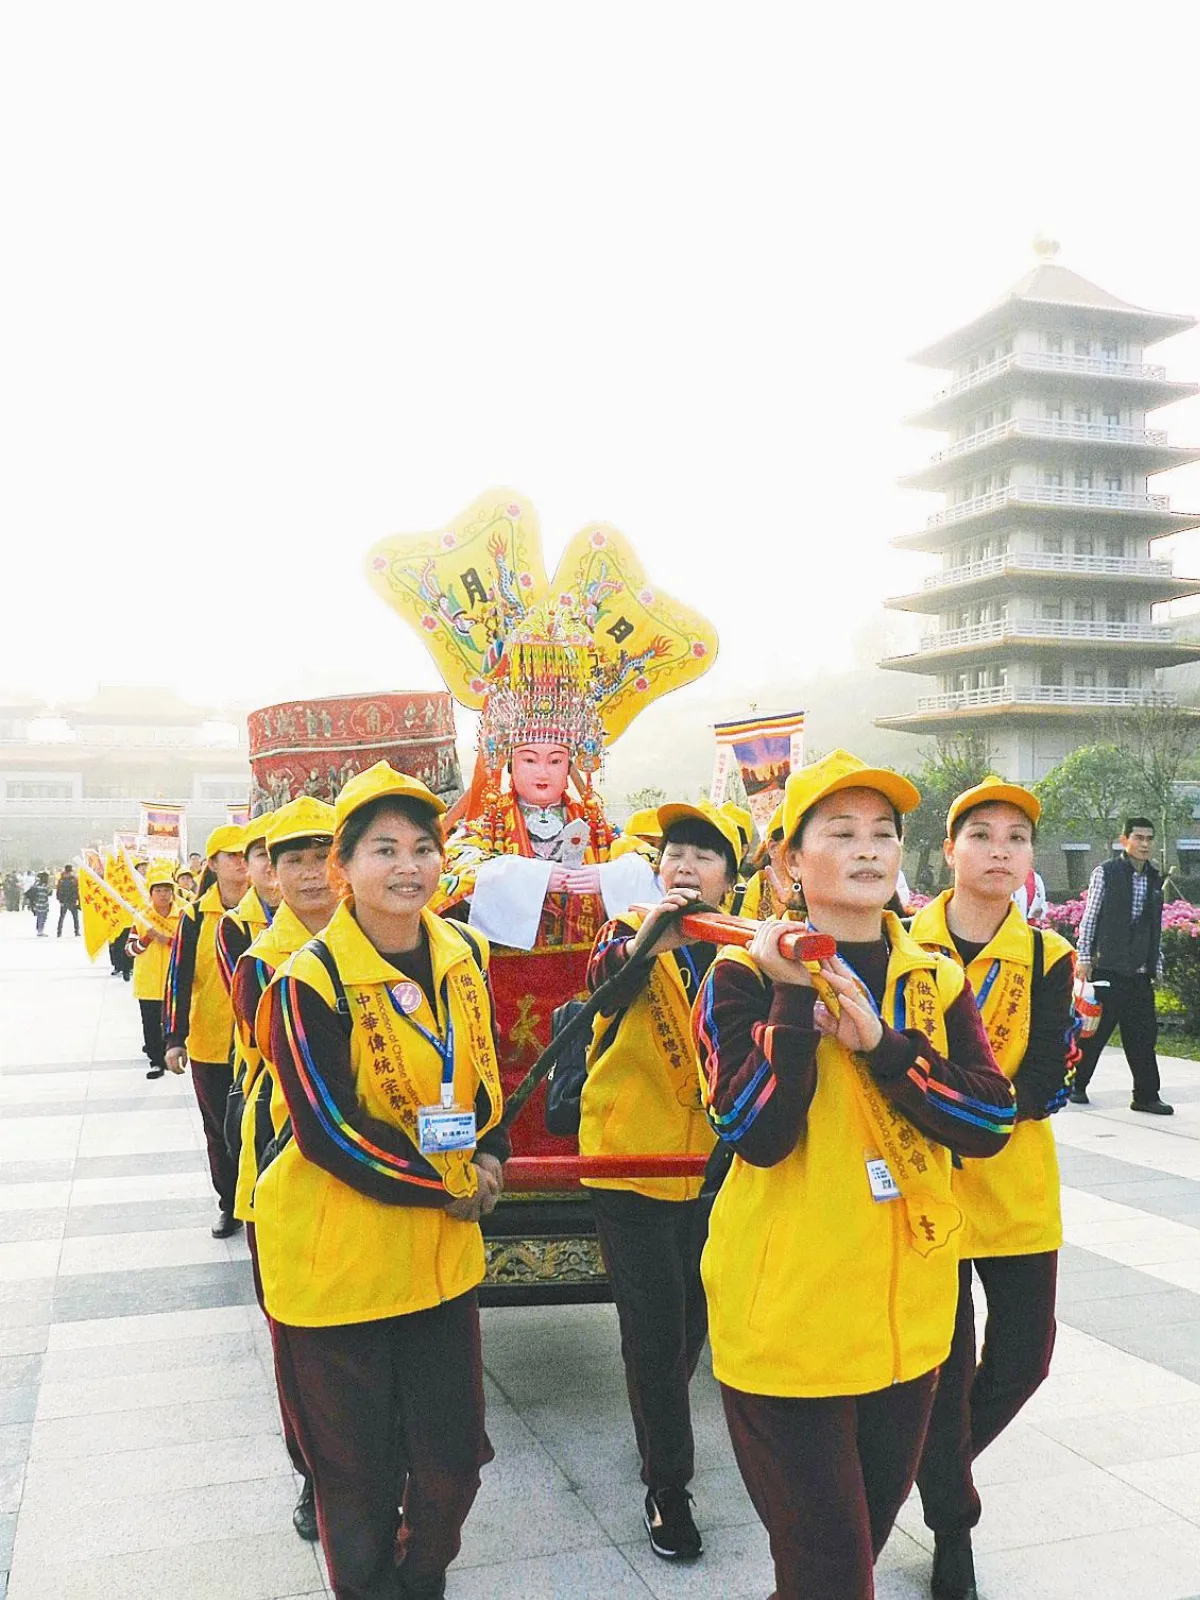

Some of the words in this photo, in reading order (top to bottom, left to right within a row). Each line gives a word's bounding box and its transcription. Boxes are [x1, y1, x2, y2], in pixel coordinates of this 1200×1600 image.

[460, 567, 488, 610] 月
[605, 615, 635, 645] 日
[356, 992, 418, 1138] 中華傳統宗教總
